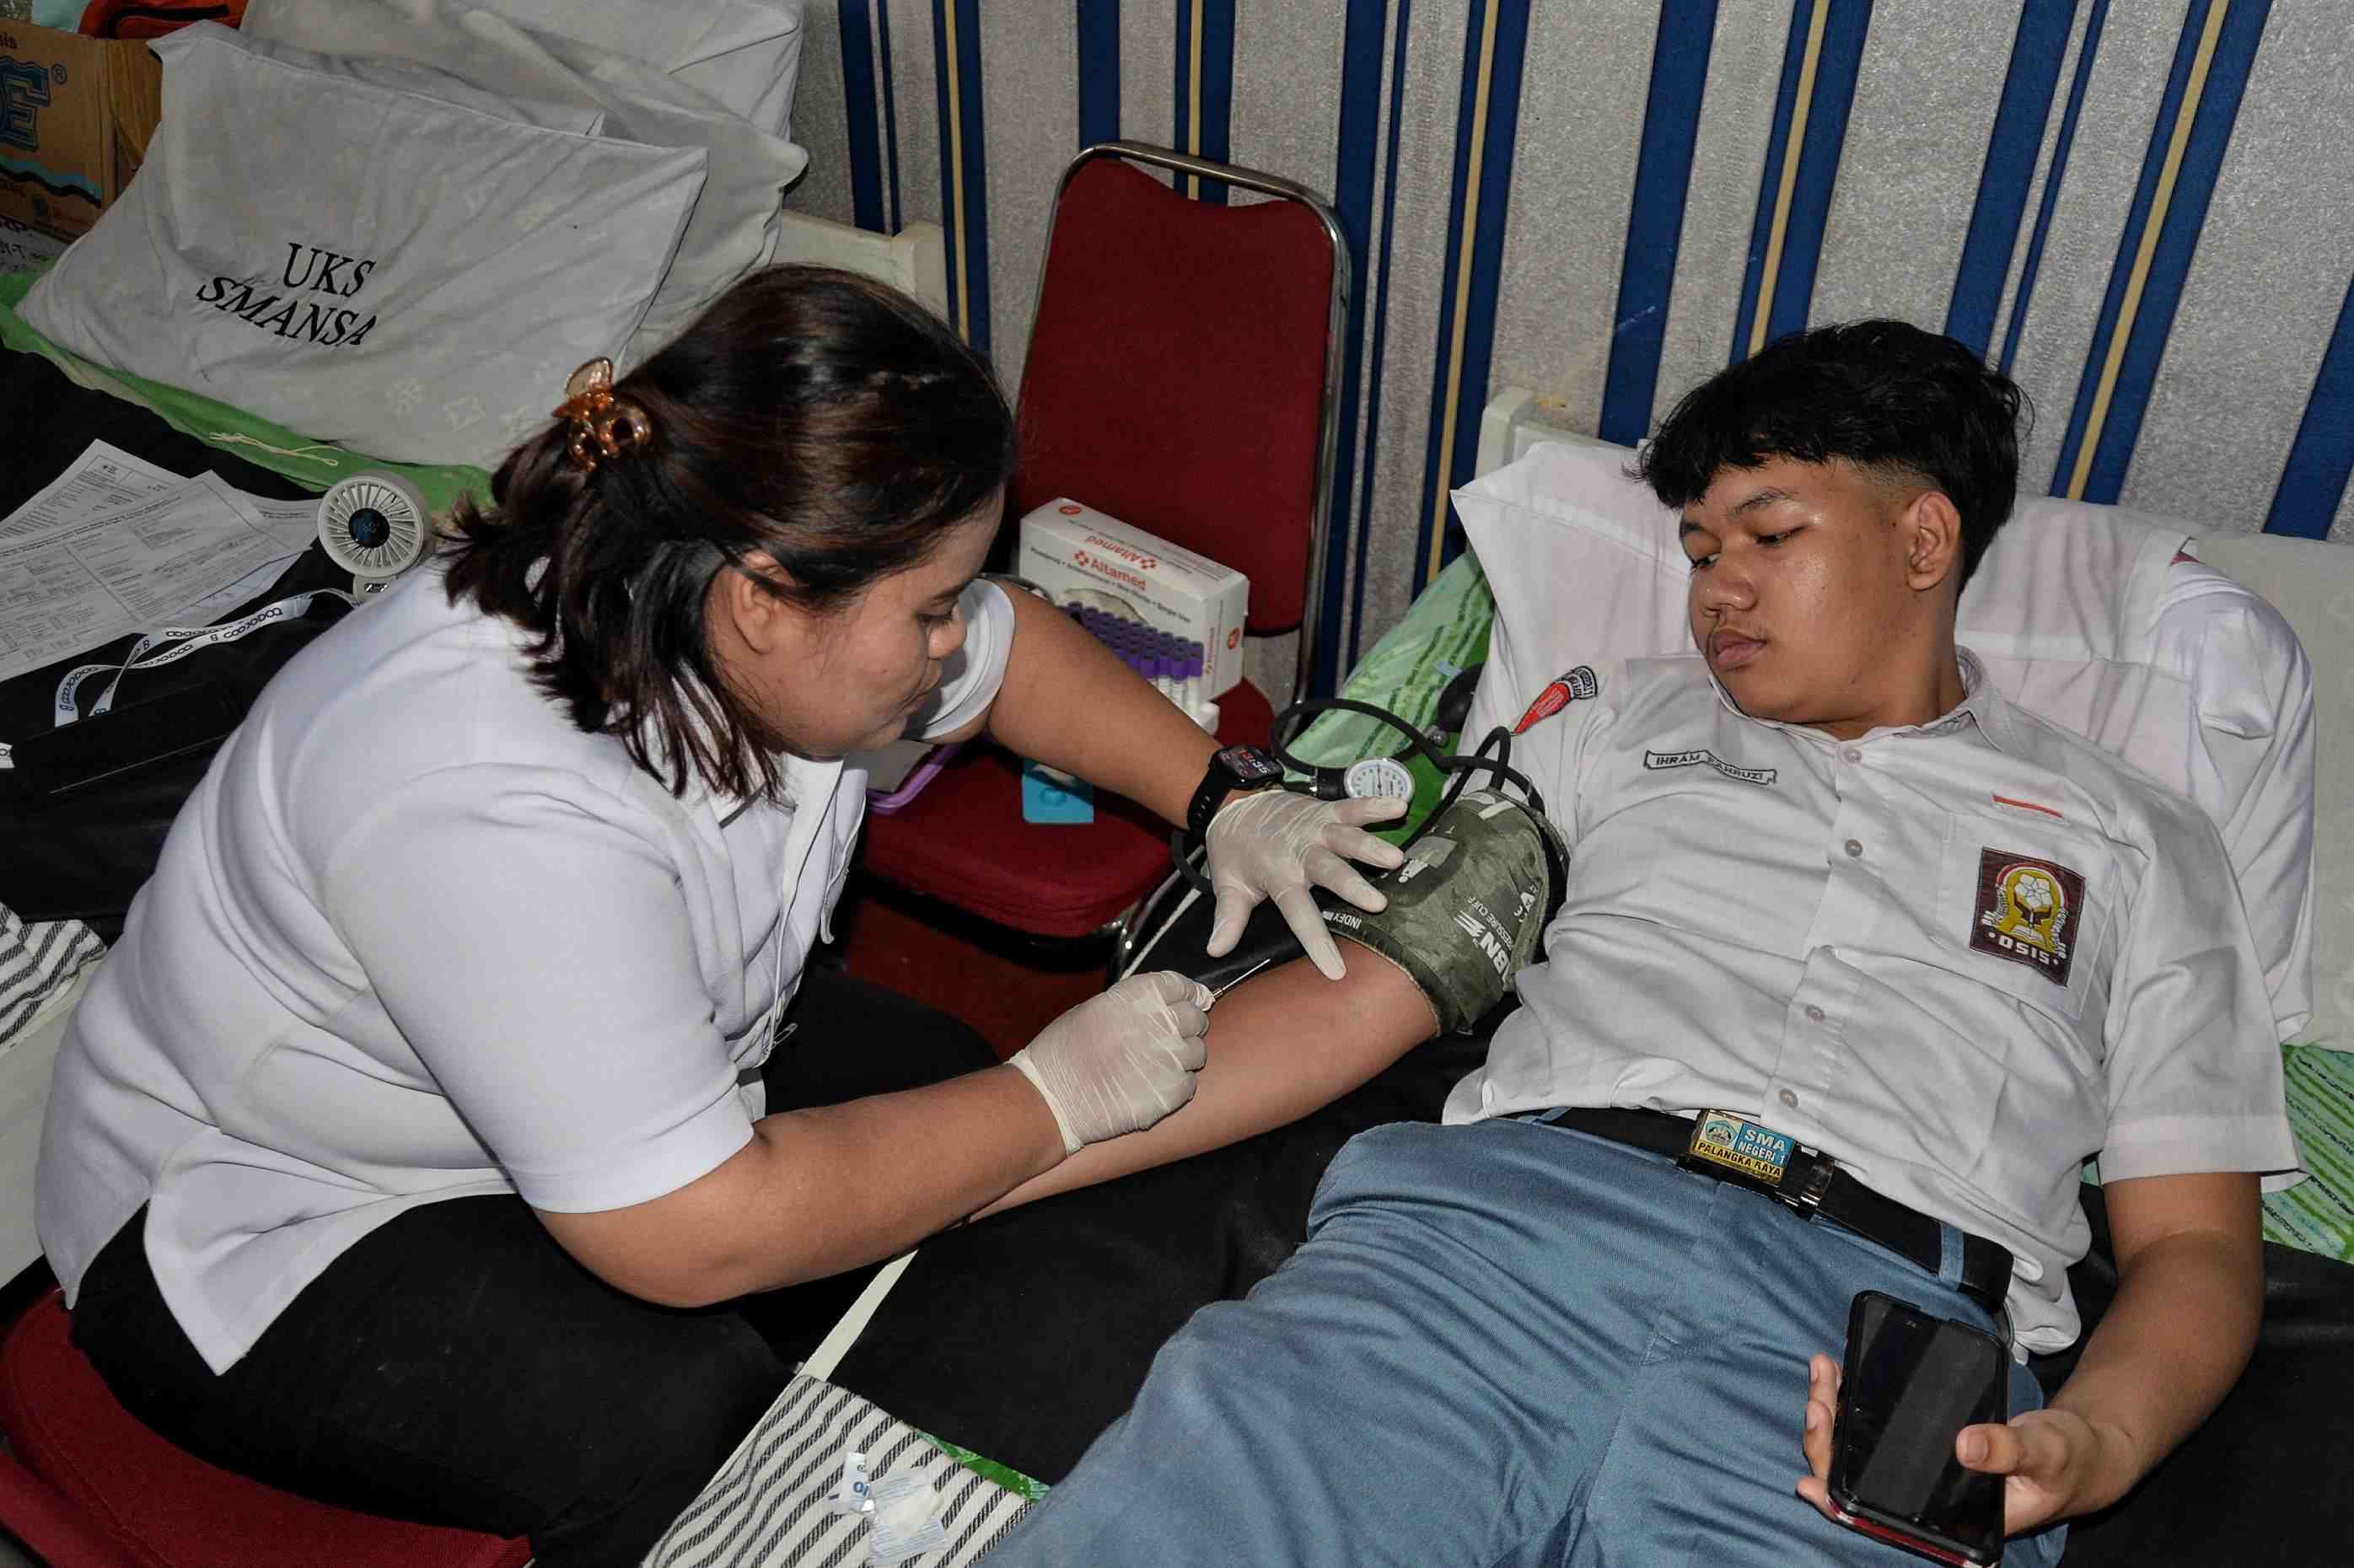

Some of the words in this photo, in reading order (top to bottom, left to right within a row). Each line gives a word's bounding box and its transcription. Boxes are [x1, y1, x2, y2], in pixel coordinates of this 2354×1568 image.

[282, 242, 377, 298] UKS
[196, 276, 378, 346] SMANSA
[1091, 558, 1147, 590] Altamed
[1998, 934, 2050, 965] OSIS
[1737, 1140, 1776, 1163] NEGERI
[1744, 1128, 1786, 1152] SMA
[1696, 1141, 1753, 1168] PALANGKA
[1754, 1159, 1782, 1177] RAYA
